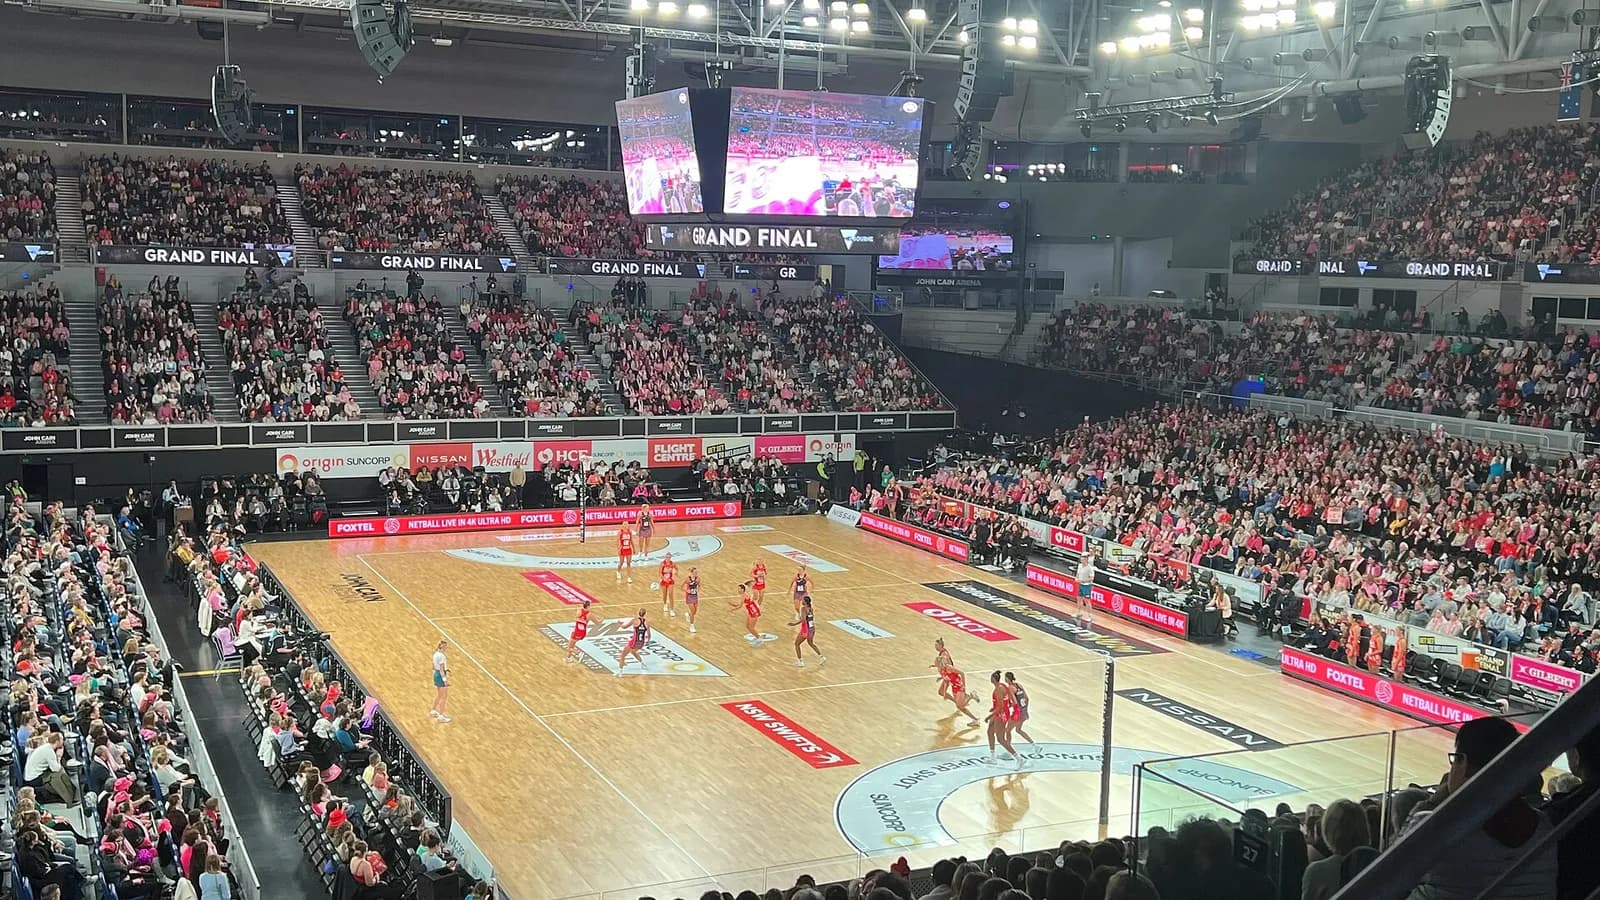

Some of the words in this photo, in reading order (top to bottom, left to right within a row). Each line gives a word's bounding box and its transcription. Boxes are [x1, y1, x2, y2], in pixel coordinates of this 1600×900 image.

[692, 226, 751, 247] GRAND
[757, 229, 818, 248] FINAL
[144, 249, 206, 263] GRAND
[210, 250, 259, 265] FINAL
[381, 256, 435, 269] GRAND
[440, 257, 483, 270] FINAL
[591, 262, 640, 275] GRAND
[643, 263, 682, 276] FINAL
[779, 267, 797, 278] GR
[1256, 260, 1292, 272] GRAND
[1406, 262, 1450, 276] GRAND
[1453, 263, 1493, 277] FINAL
[915, 278, 936, 286] JOHN
[555, 449, 589, 462] HCF
[654, 443, 696, 454] FLIGHT
[767, 445, 804, 453] GILBERT
[302, 456, 344, 473] origin
[346, 456, 391, 466] SUNCORP
[416, 455, 468, 464] NISSAN
[476, 448, 531, 467] Westfield
[653, 452, 696, 463] CENTRE
[585, 511, 613, 521] NETBALL
[614, 510, 629, 519] LIVE
[629, 510, 637, 518] IN
[650, 508, 667, 516] LTRA
[667, 508, 678, 516] HD
[685, 506, 716, 515] FOXTEL
[408, 519, 440, 529] NETBALL
[441, 518, 457, 528] LIVE
[457, 518, 466, 527] IN
[466, 517, 477, 526] 4K
[477, 517, 500, 526] ULTRA
[500, 517, 512, 525] HD
[520, 514, 554, 524] FOXTEL
[336, 522, 375, 533] FOXTEL
[1063, 534, 1079, 547] HCF
[1066, 581, 1074, 593] HD
[1128, 603, 1156, 620] NETBALL
[1156, 612, 1169, 624] LIVE
[940, 616, 998, 634] HCF
[1280, 654, 1305, 670] ULTRA
[1305, 659, 1317, 674] HD
[1475, 653, 1505, 667] GRAND
[1480, 661, 1502, 674] FINAL
[1326, 668, 1366, 691] FOXTEL
[1528, 667, 1576, 689] GILBERT
[1402, 693, 1441, 716] NETBALL
[1441, 706, 1462, 723] LIVE
[1462, 712, 1474, 723] IN
[1130, 691, 1268, 746] NISSAN
[735, 703, 776, 721] NSW
[764, 721, 823, 753] SWIFTS
[892, 768, 938, 790] SHOT
[1176, 767, 1277, 795] SUNCORP
[869, 792, 906, 833] SUNCORP
